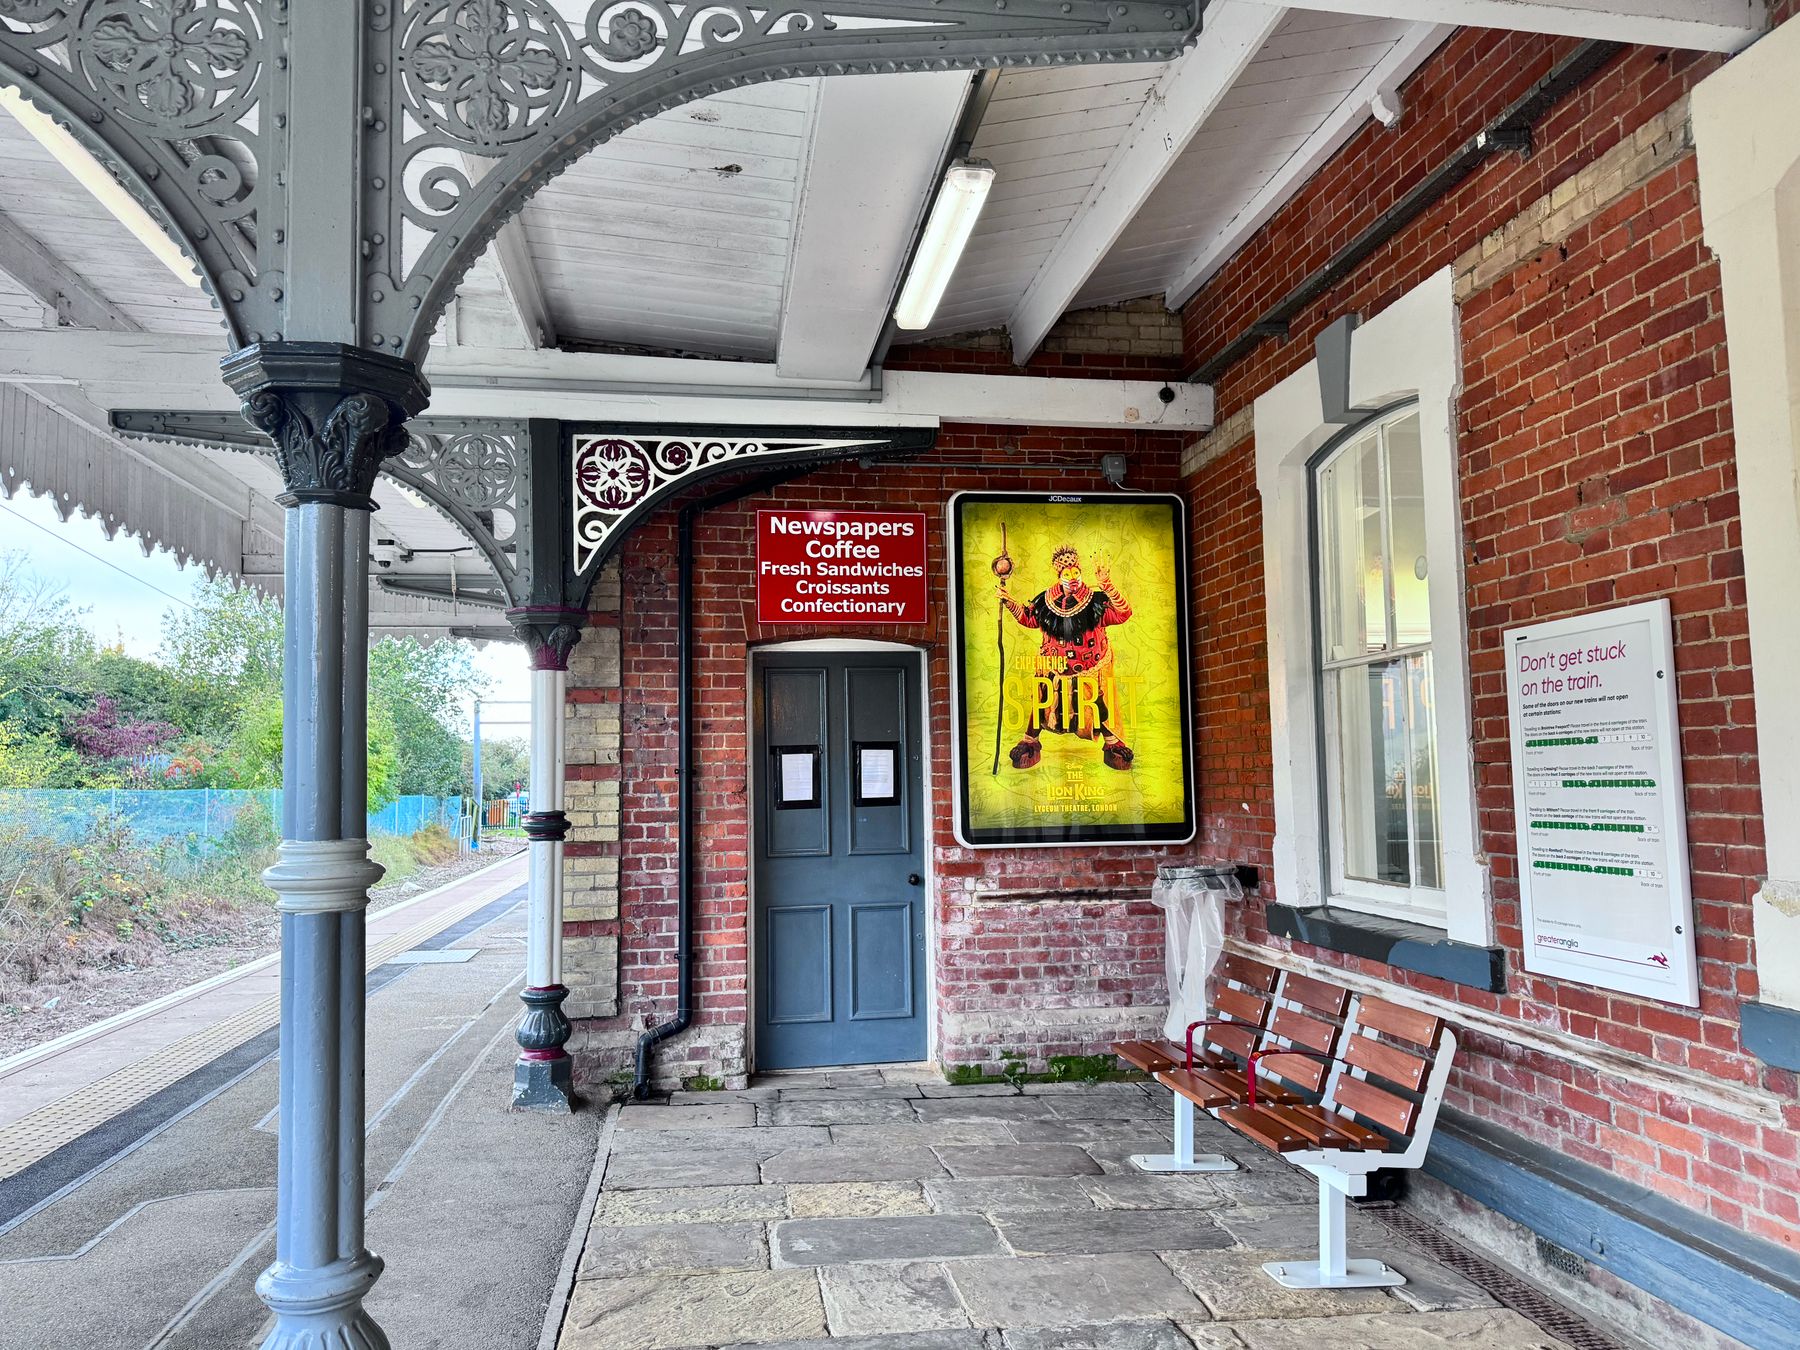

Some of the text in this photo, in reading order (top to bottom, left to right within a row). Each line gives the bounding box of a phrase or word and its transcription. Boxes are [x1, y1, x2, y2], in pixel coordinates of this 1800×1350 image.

[1048, 495, 1082, 503] JCDecaux
[770, 516, 915, 540] Newspapers
[805, 540, 880, 559] Coffee
[761, 561, 924, 577] Fresh Sandwiches
[795, 580, 890, 595] Croissants
[780, 598, 906, 616] Confectionary
[1015, 655, 1069, 672] EXPERIENCE
[1520, 640, 1626, 672] Don't get stuck
[1521, 671, 1602, 696] on the train.
[1002, 676, 1144, 730] SPIRIT
[1066, 771, 1084, 779] THE
[1047, 783, 1105, 800] LION KING
[1034, 805, 1060, 813] LYCEUM
[1092, 804, 1118, 812] LONDON
[1536, 934, 1578, 948] greateranglia
